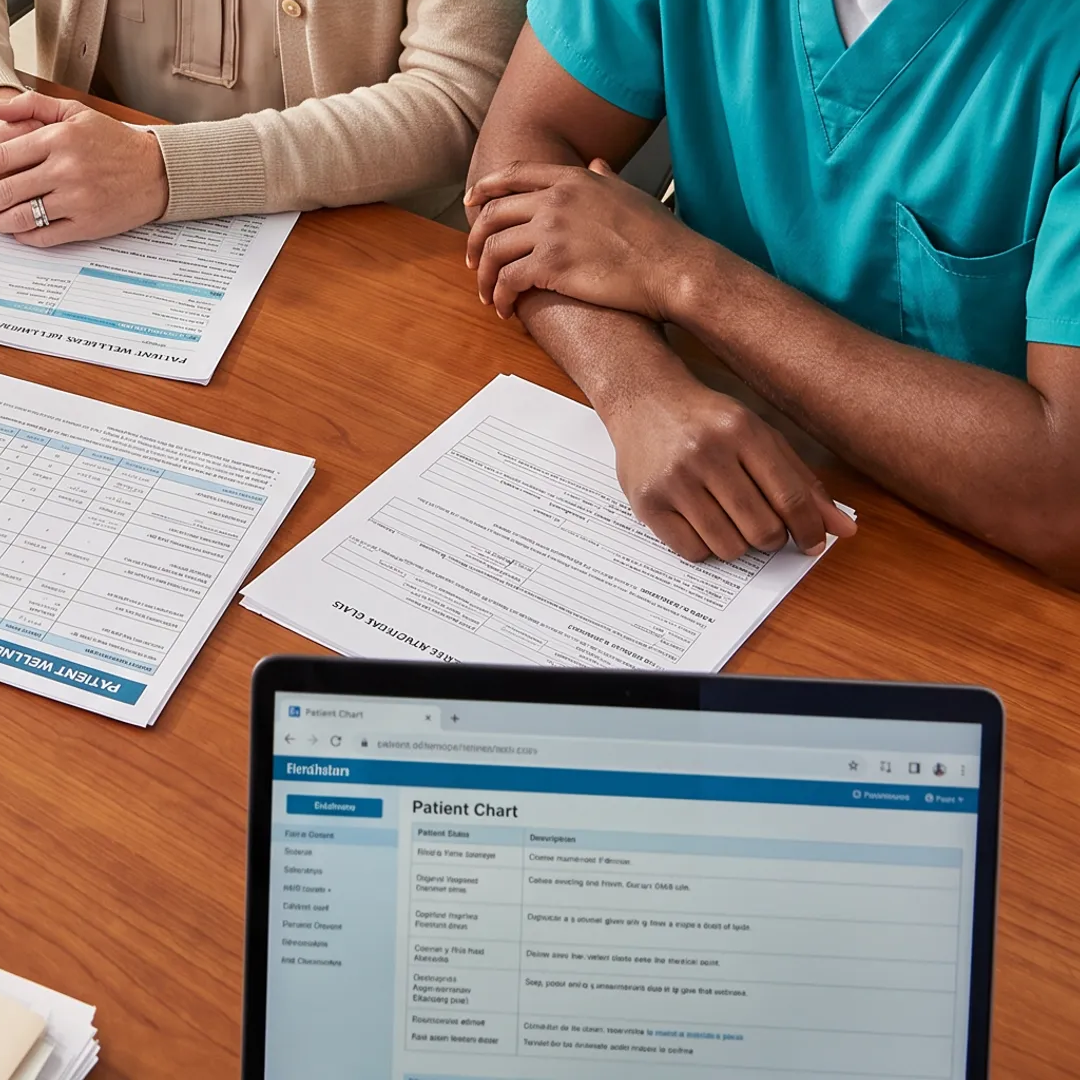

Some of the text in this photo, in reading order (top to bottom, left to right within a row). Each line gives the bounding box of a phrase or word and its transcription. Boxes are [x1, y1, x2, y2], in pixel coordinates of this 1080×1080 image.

[54, 667, 122, 694] PATIENT
[305, 708, 364, 720] Patient Chart
[412, 800, 519, 818] Patient Chart
